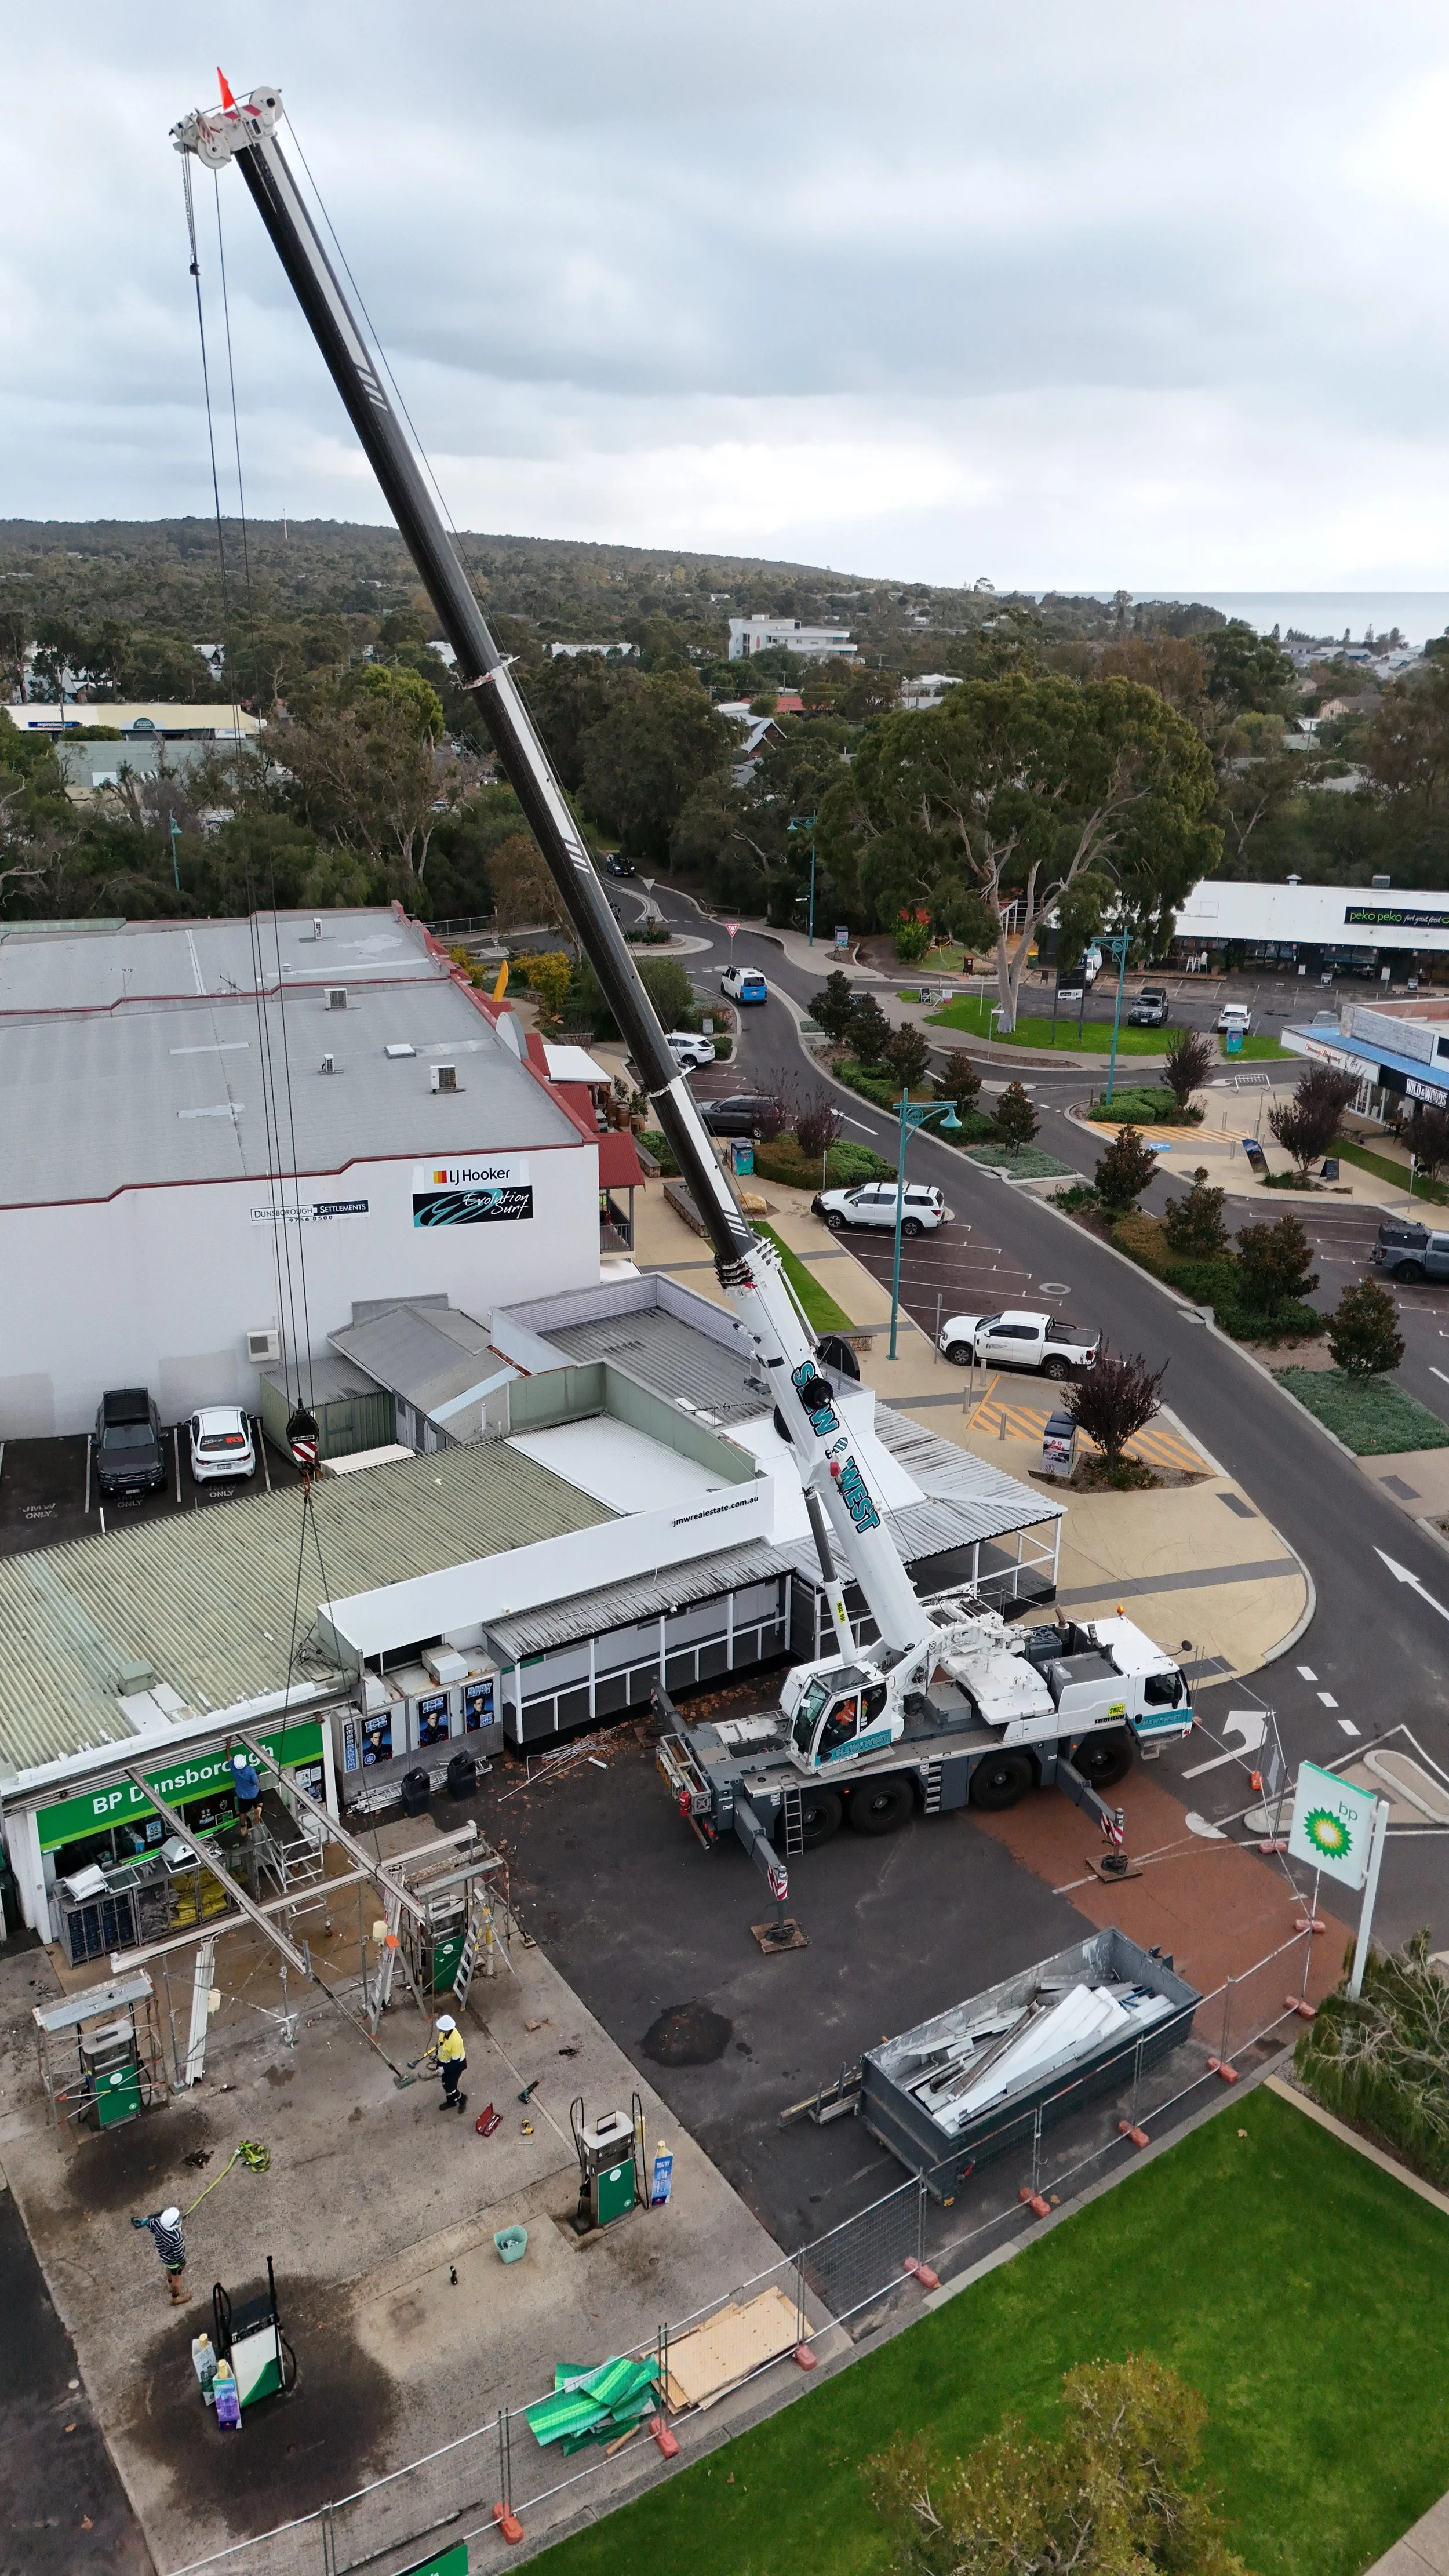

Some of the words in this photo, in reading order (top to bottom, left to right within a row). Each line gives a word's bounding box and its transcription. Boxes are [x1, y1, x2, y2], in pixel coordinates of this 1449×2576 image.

[1350, 909, 1375, 922] peko
[1377, 911, 1402, 923] peko
[1428, 916, 1442, 925] food
[449, 1170, 460, 1185] LJ
[462, 1167, 510, 1182] Hooker
[463, 1191, 530, 1206] Evolution
[490, 1203, 529, 1219] Surf
[839, 1456, 880, 1533] WEST
[117, 1500, 143, 1508] ONLY
[673, 1496, 759, 1527] jmwrealestate.com.au
[26, 1511, 52, 1519] ONLY
[467, 1683, 492, 1698] BABY
[423, 1697, 444, 1713] ICE
[1109, 1705, 1124, 1715] SW022
[365, 1715, 387, 1733] ICE
[1095, 1714, 1125, 1724] LIEBHERR
[1163, 1713, 1182, 1723] WEST
[835, 1743, 859, 1757] SLEW
[864, 1733, 889, 1747] WEST
[93, 1792, 122, 1815] BP
[1338, 1800, 1358, 1821] bp
